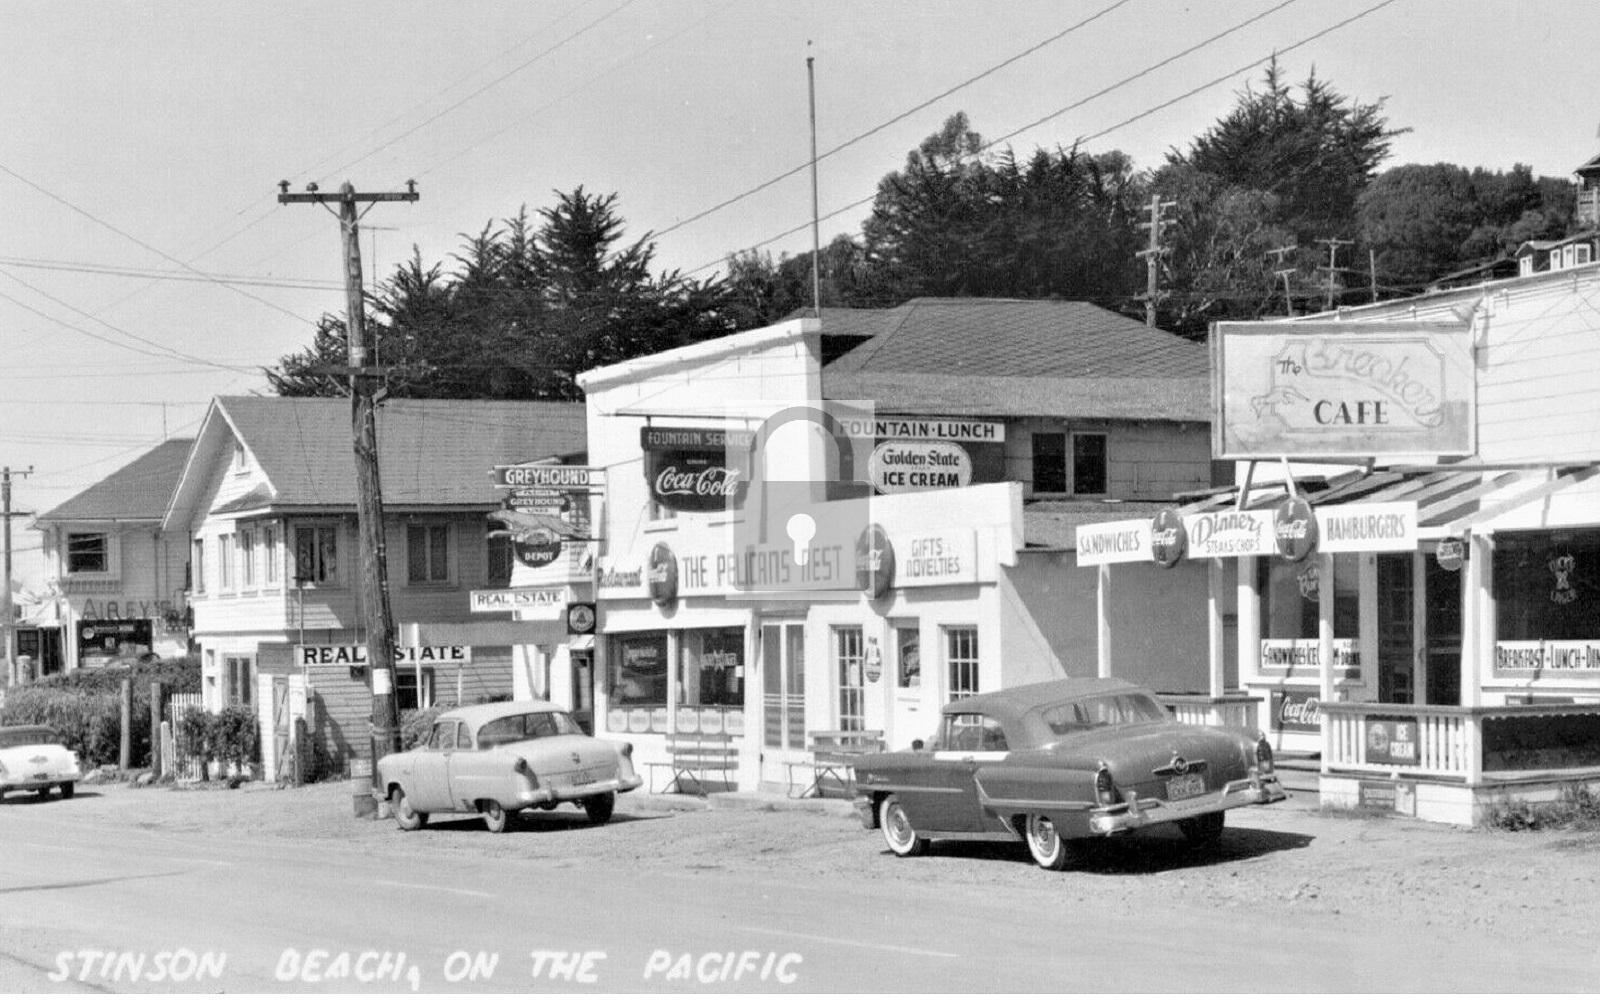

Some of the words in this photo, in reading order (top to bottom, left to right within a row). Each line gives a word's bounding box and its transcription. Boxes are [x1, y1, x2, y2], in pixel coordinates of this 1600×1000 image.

[1275, 356, 1303, 376] The
[1313, 400, 1389, 425] CAFE
[648, 432, 702, 446] FOUNTAIN
[705, 433, 753, 448] SERVICE
[883, 449, 927, 466] Golden
[928, 450, 960, 467] State
[505, 469, 588, 485] GREYHOUND
[656, 466, 741, 496] Coca-Cola
[883, 472, 906, 486] ICE
[909, 472, 960, 487] CREAM
[510, 498, 565, 506] GREYHOUND
[1326, 514, 1406, 541] HAMBURGERS
[912, 537, 943, 557] GIFTS
[1079, 530, 1141, 556] SANDWICHES
[525, 552, 553, 560] DEPOT
[681, 555, 708, 589] THE
[906, 556, 960, 577] NOVELTIES
[477, 593, 510, 605] REAL
[514, 592, 561, 603] ESTATE
[303, 646, 366, 664] REAL
[393, 646, 465, 661] STATE
